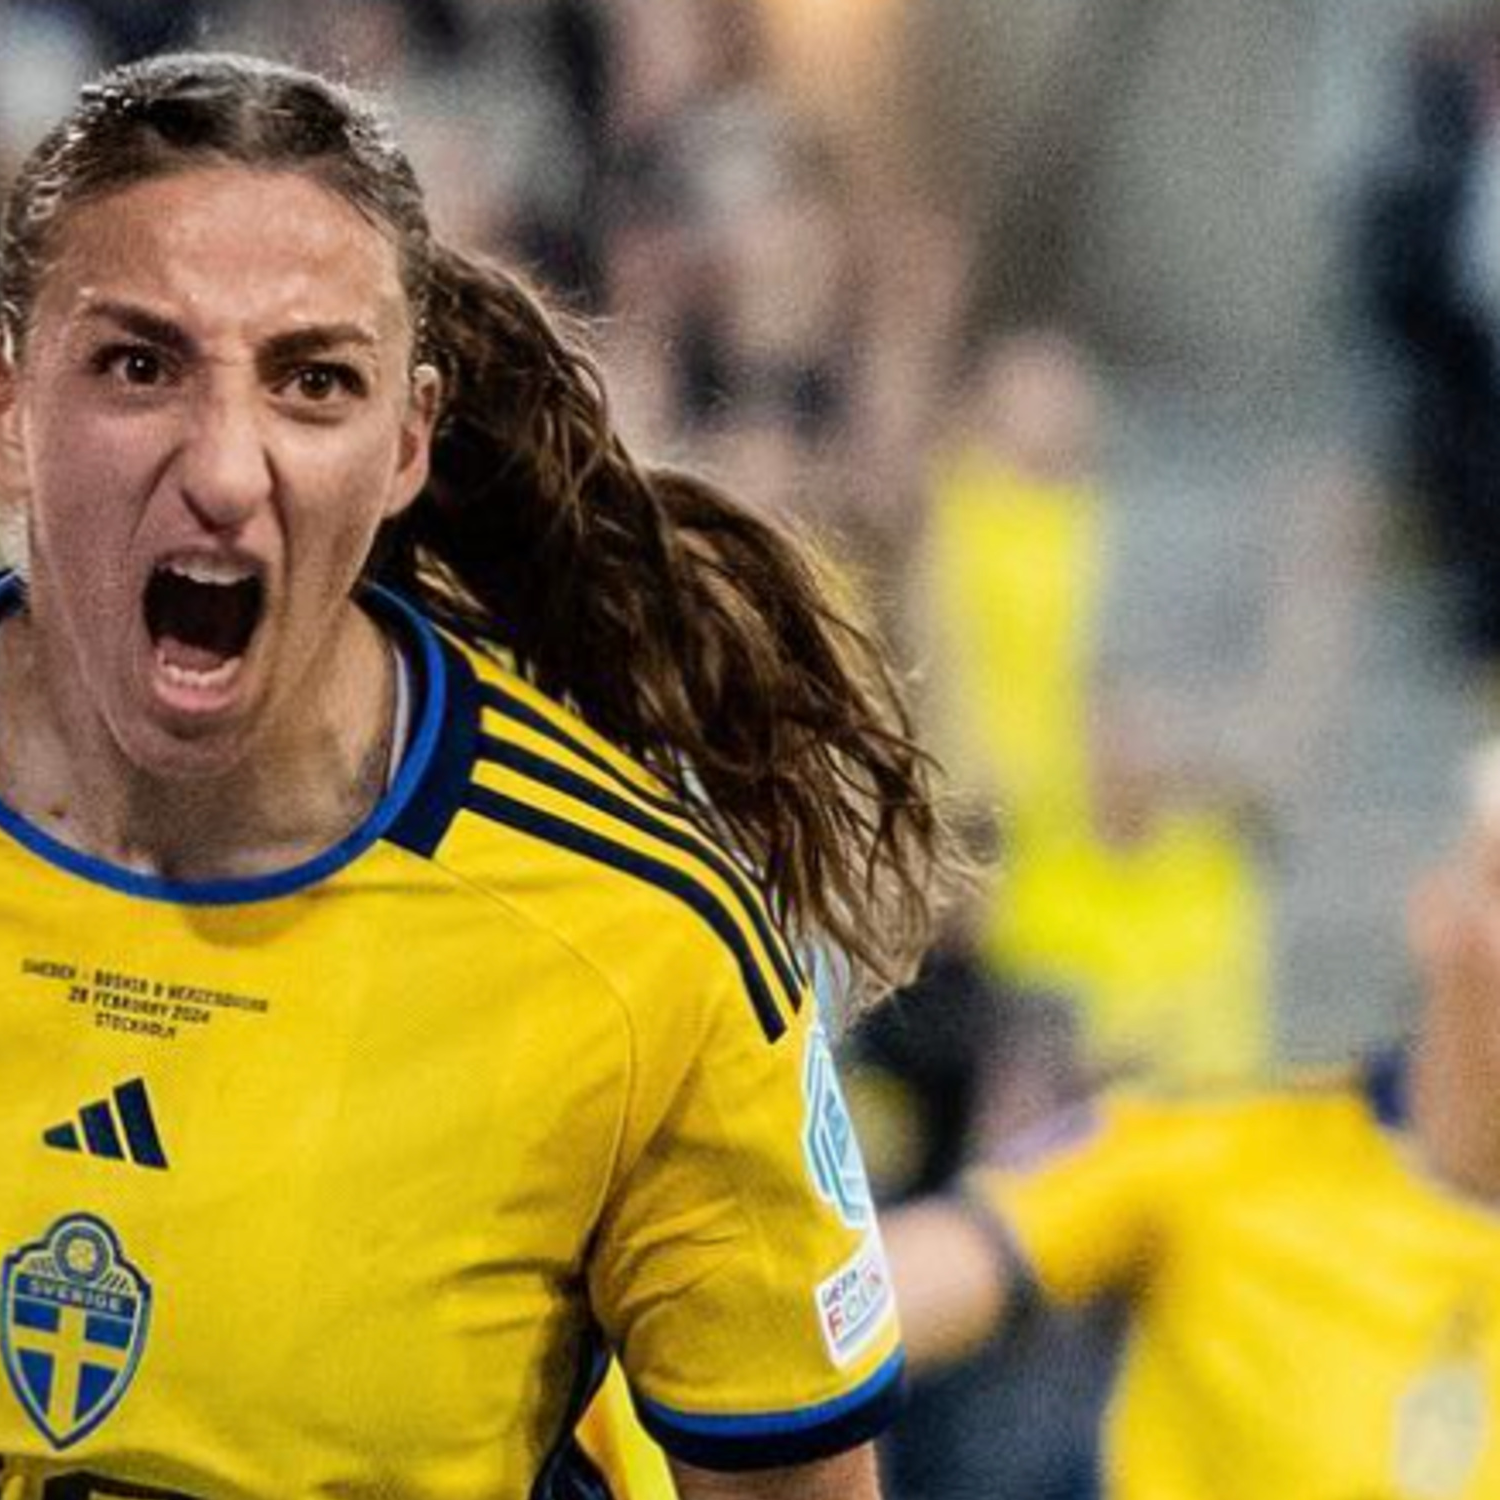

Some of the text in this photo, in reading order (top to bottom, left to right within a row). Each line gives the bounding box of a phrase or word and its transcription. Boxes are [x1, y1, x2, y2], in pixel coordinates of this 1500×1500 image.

[95, 969, 149, 995] BOSNIA
[93, 991, 170, 1018] FEBRUARY
[95, 1012, 177, 1041] STOCKHOLM
[30, 1277, 121, 1313] SVERIGE
